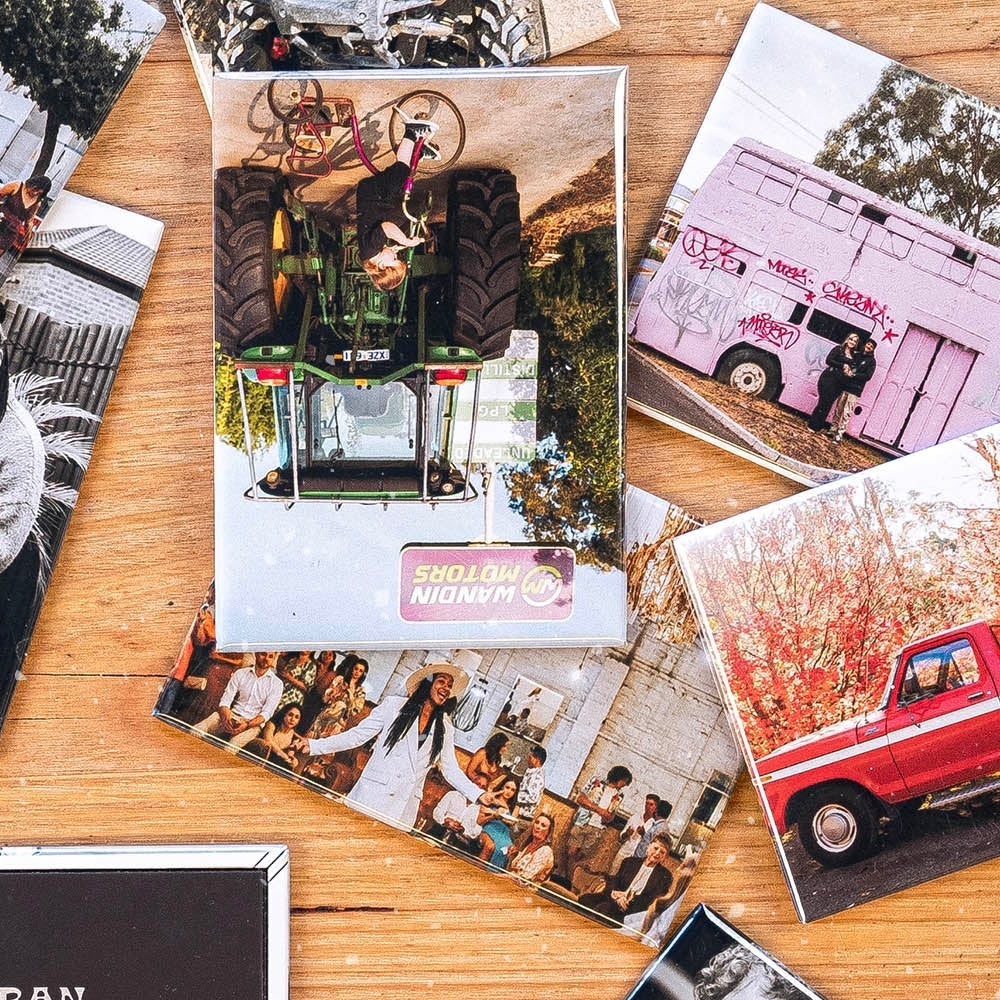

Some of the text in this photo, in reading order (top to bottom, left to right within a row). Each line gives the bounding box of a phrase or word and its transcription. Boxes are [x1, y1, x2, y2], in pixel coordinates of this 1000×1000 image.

[479, 405, 510, 417] LPG
[455, 447, 531, 460] UNLEADD
[412, 564, 521, 584] MOTORS
[409, 585, 517, 604] WANDIN
